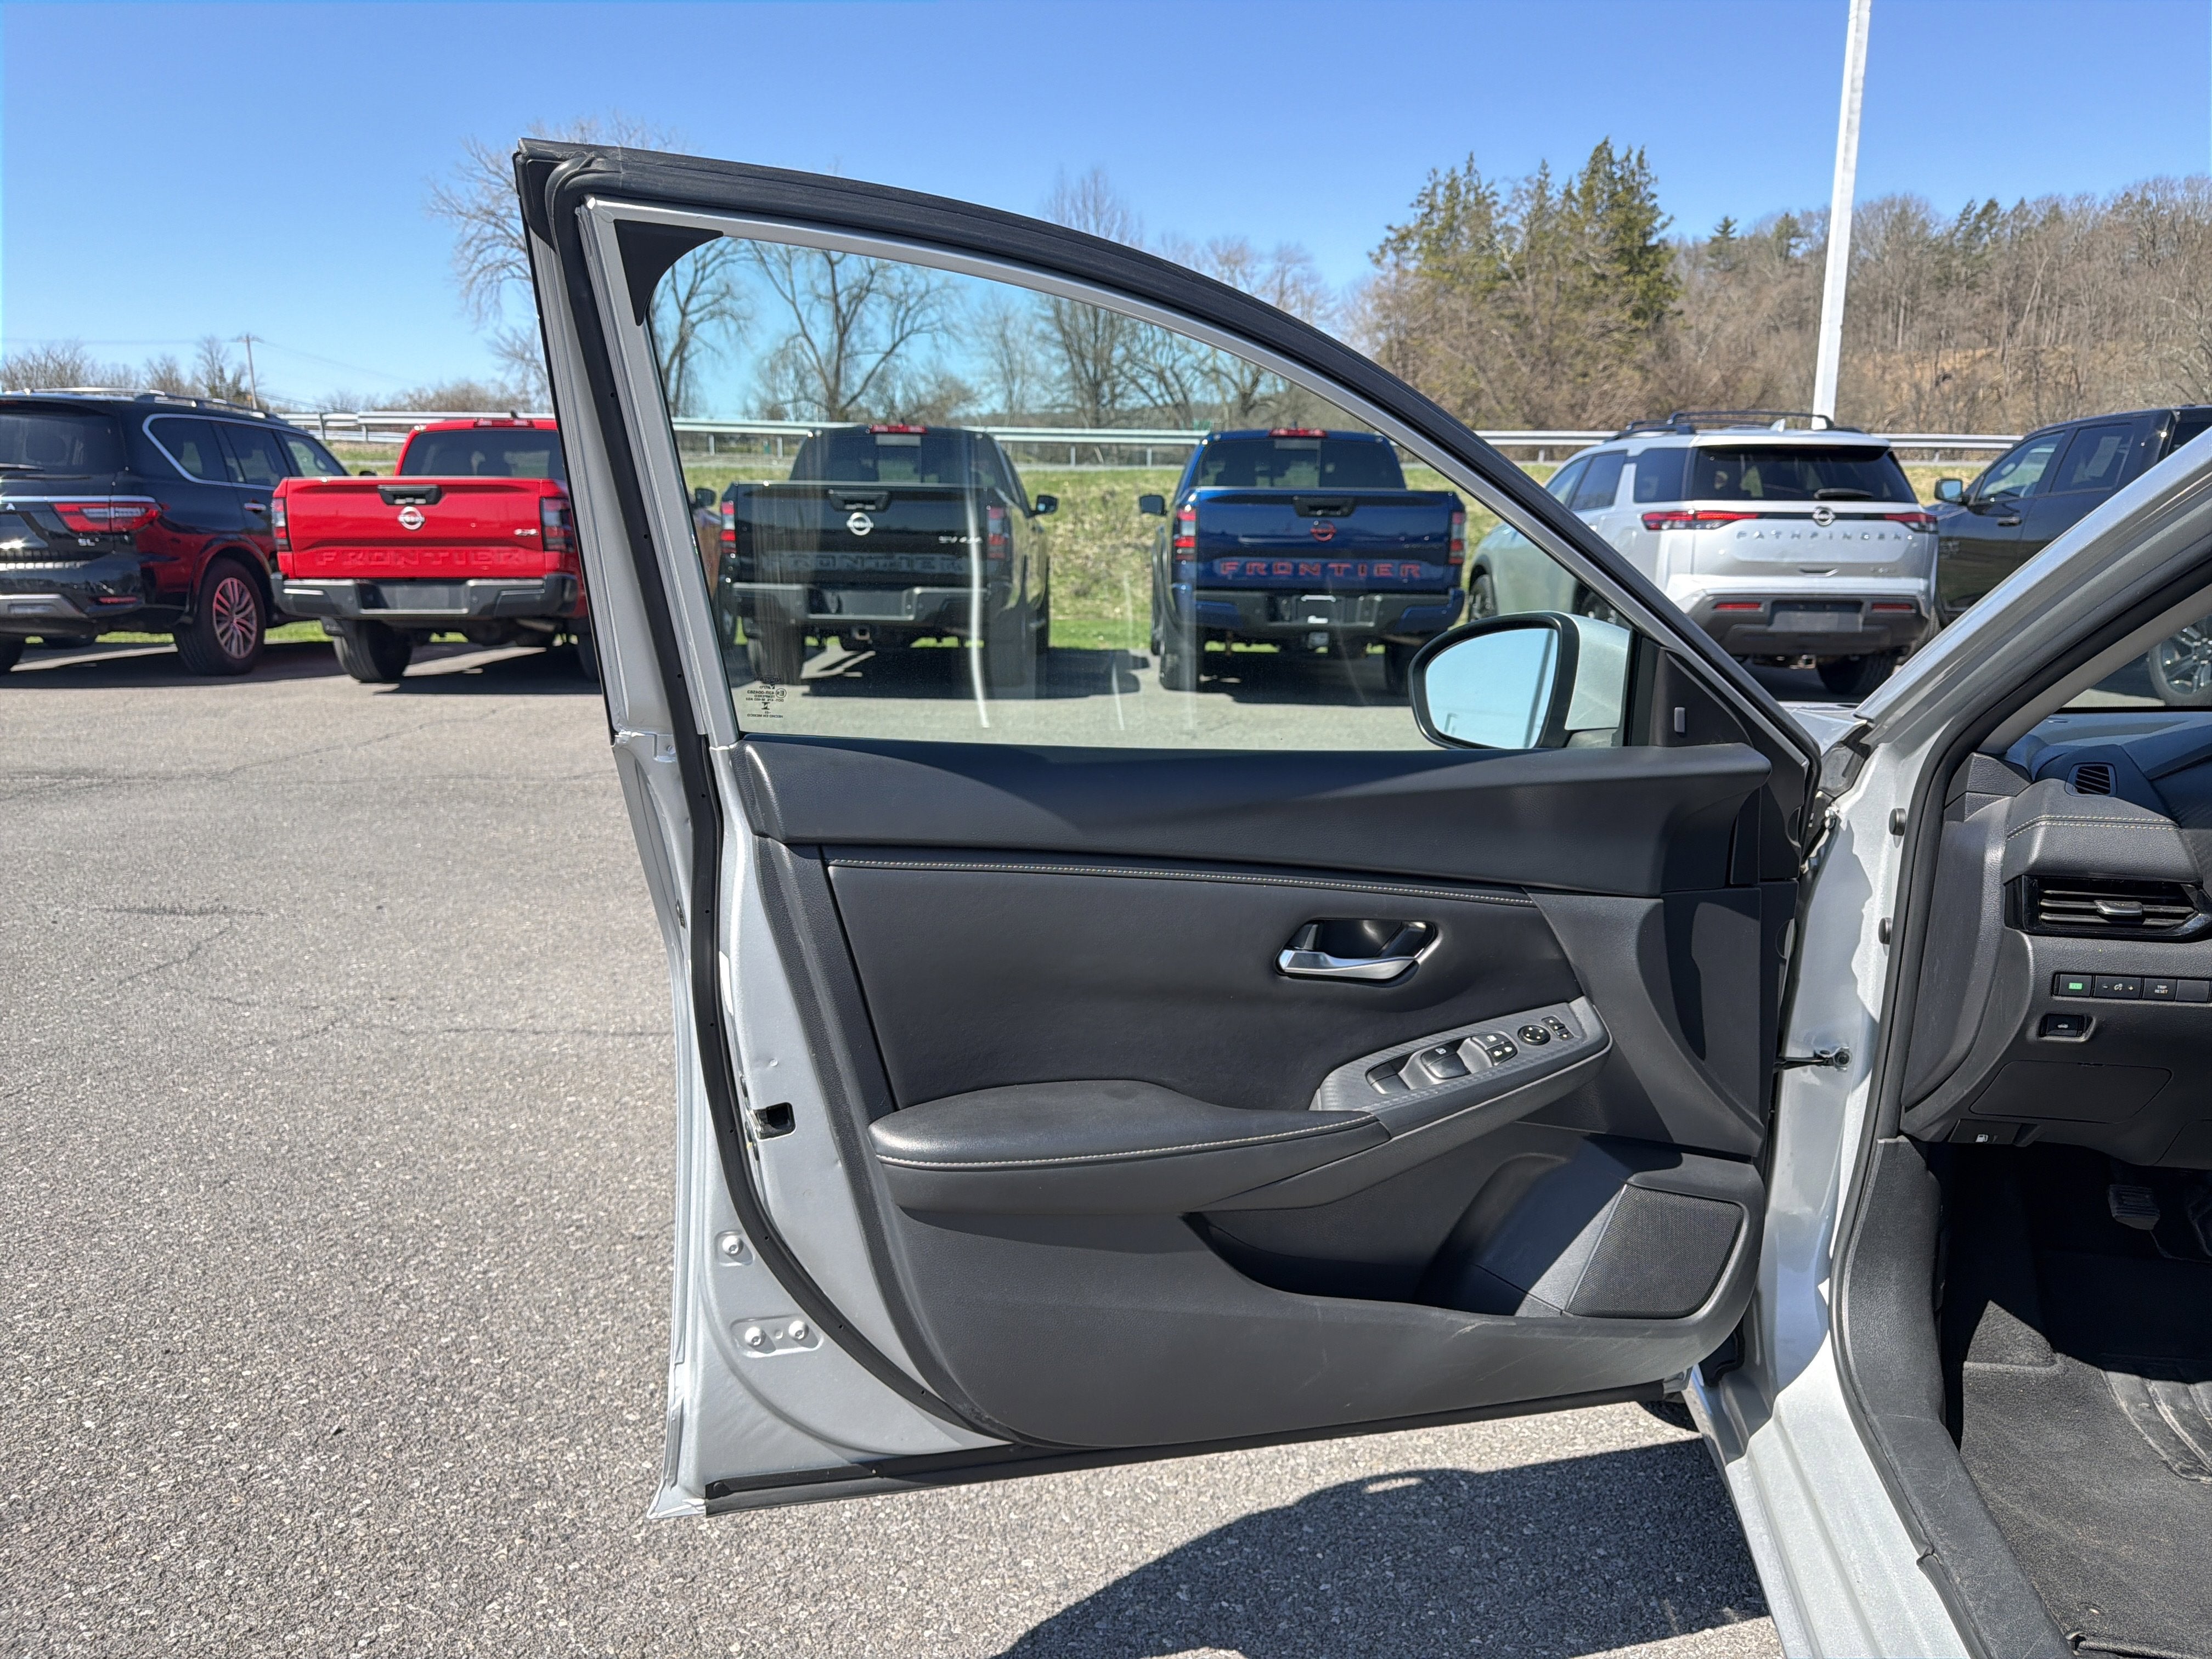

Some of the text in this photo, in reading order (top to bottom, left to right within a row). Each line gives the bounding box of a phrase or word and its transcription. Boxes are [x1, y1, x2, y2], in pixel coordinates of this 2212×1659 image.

[1736, 530, 1901, 540] PATHFINDER
[315, 550, 522, 566] FRONTIER
[767, 553, 964, 571] RONTIER
[1220, 561, 1421, 578] FRONTIER
